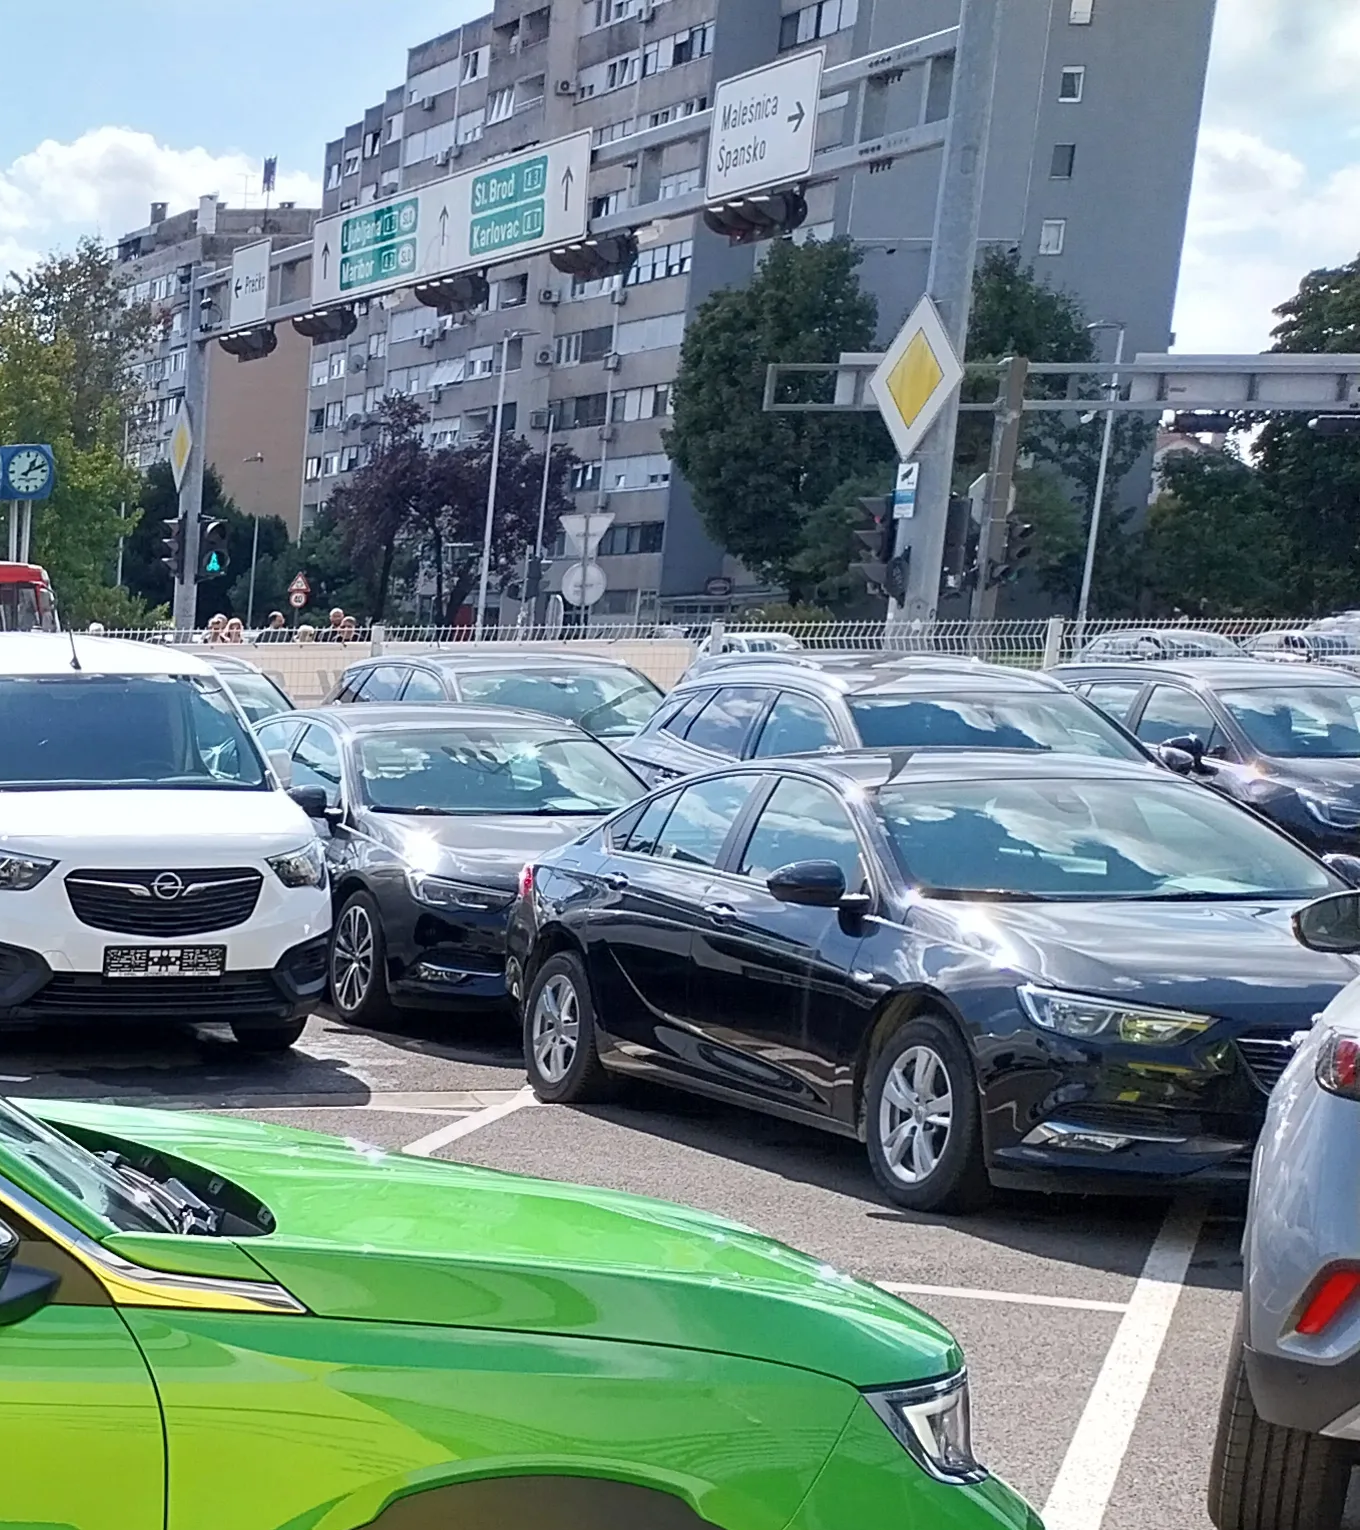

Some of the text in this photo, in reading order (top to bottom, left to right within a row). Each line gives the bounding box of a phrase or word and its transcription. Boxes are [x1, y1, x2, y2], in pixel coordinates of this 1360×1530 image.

[721, 93, 779, 131] Malešnica
[718, 136, 766, 178] Špansko
[489, 172, 515, 203] Brod
[343, 216, 382, 251] Ljubljana
[473, 219, 519, 249] Karlovac
[342, 258, 375, 284] Maribor
